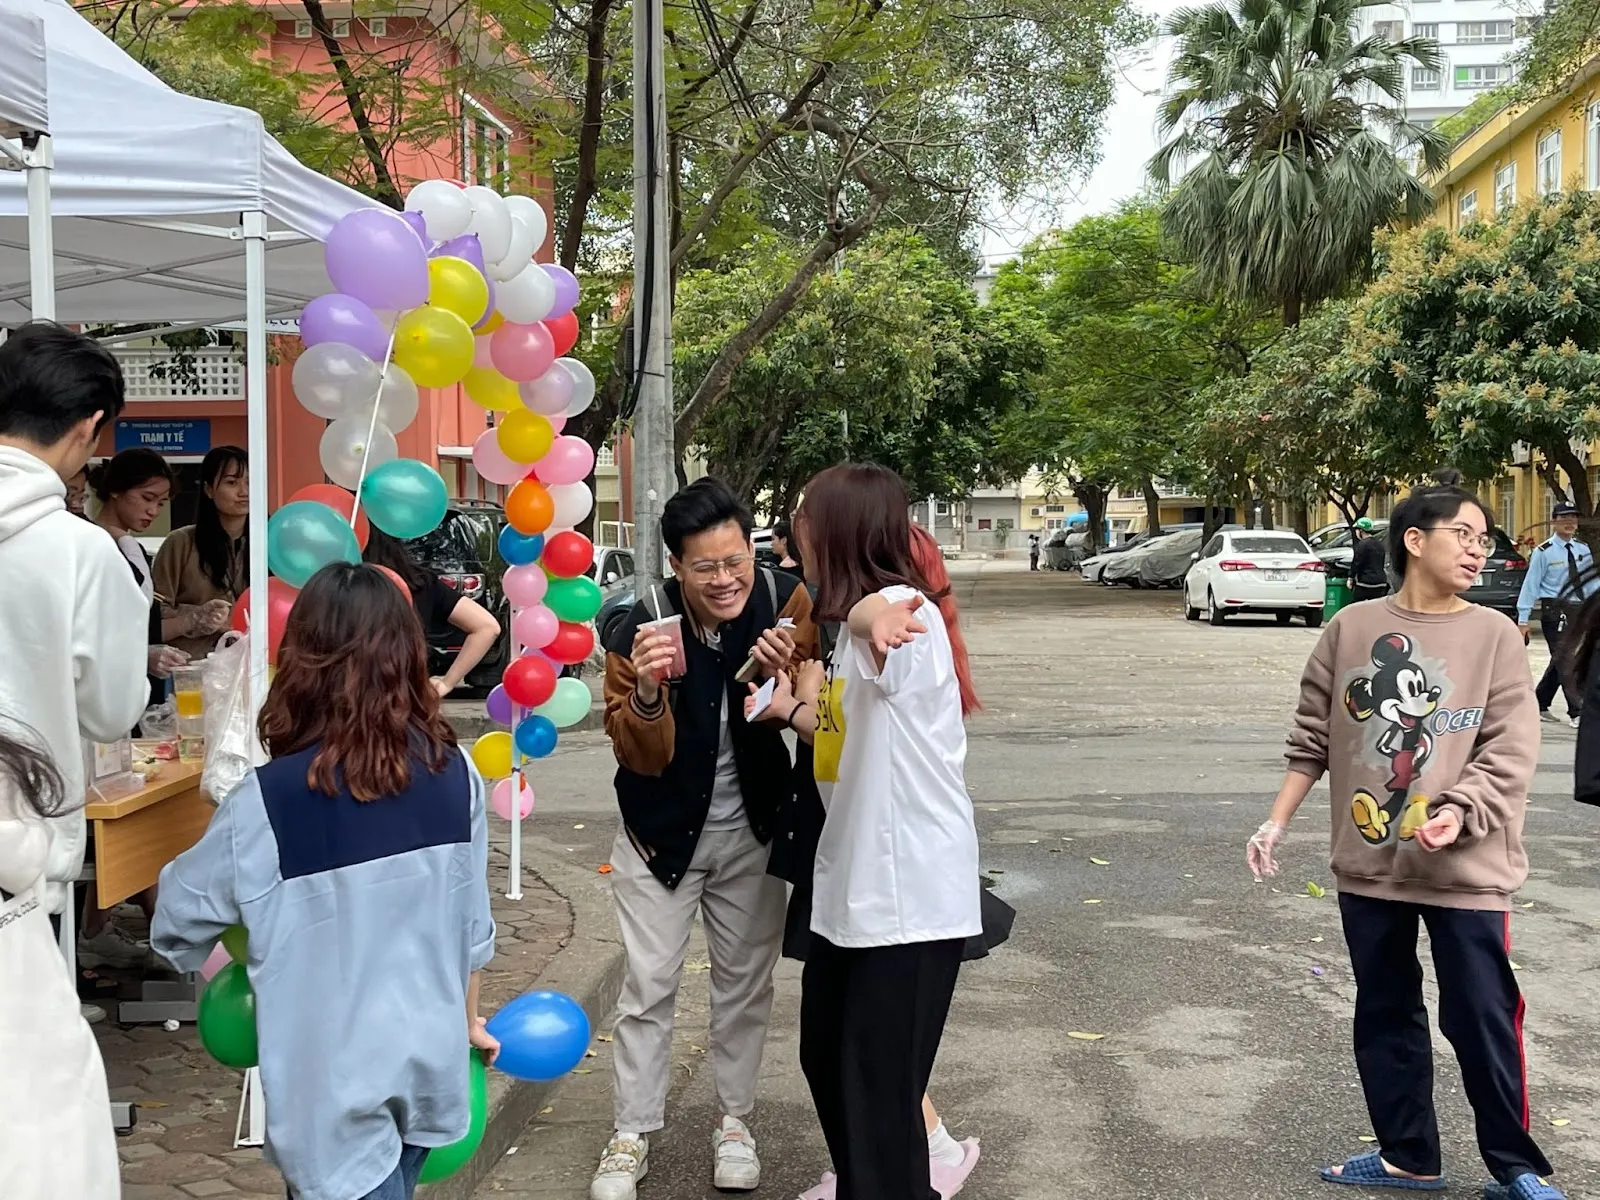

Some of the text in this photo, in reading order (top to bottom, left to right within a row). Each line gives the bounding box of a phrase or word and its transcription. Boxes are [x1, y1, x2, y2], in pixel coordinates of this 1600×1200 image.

[140, 429, 184, 444] TRẠM Y TẾ
